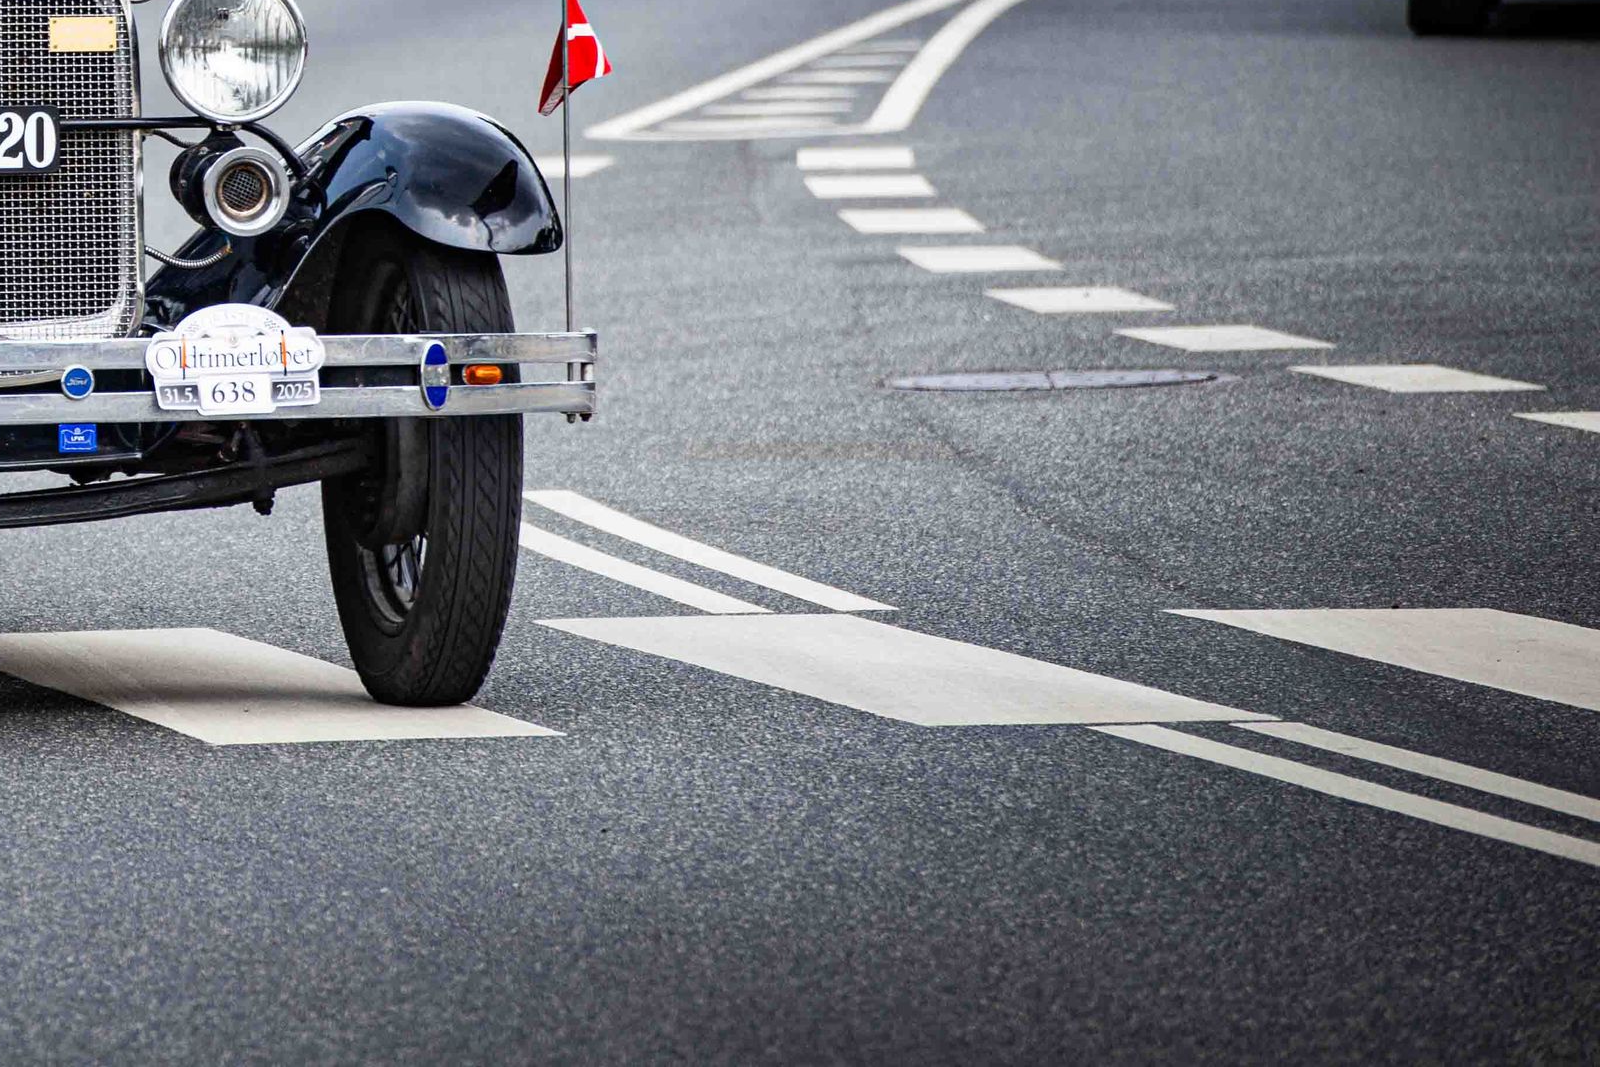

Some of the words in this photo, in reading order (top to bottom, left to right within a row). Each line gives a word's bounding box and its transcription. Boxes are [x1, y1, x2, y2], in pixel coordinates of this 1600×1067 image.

[156, 342, 313, 370] Oldtimerløbet
[164, 387, 198, 405] 31.5.
[212, 381, 256, 404] 638
[276, 383, 312, 400] 2025
